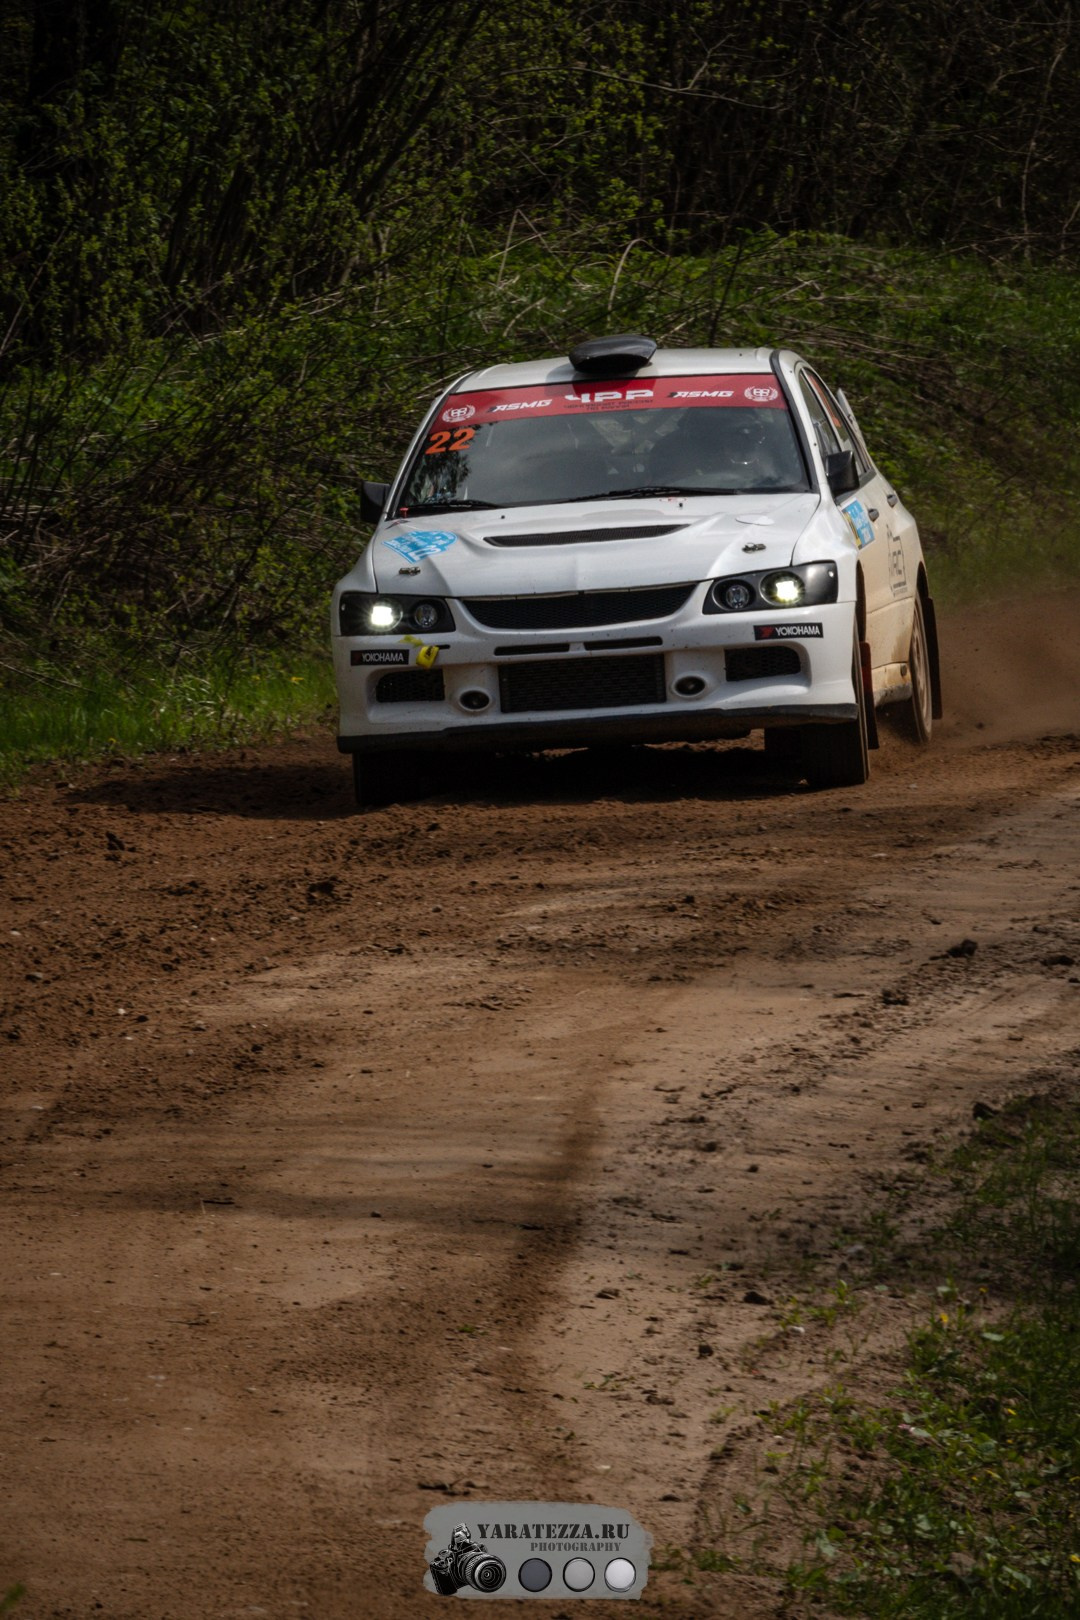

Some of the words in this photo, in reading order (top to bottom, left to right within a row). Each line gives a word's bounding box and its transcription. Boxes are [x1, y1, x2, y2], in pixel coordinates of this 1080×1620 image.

[425, 428, 476, 455] 22
[775, 625, 821, 637] YOKOHAMA
[361, 652, 405, 663] YOKOHAMA
